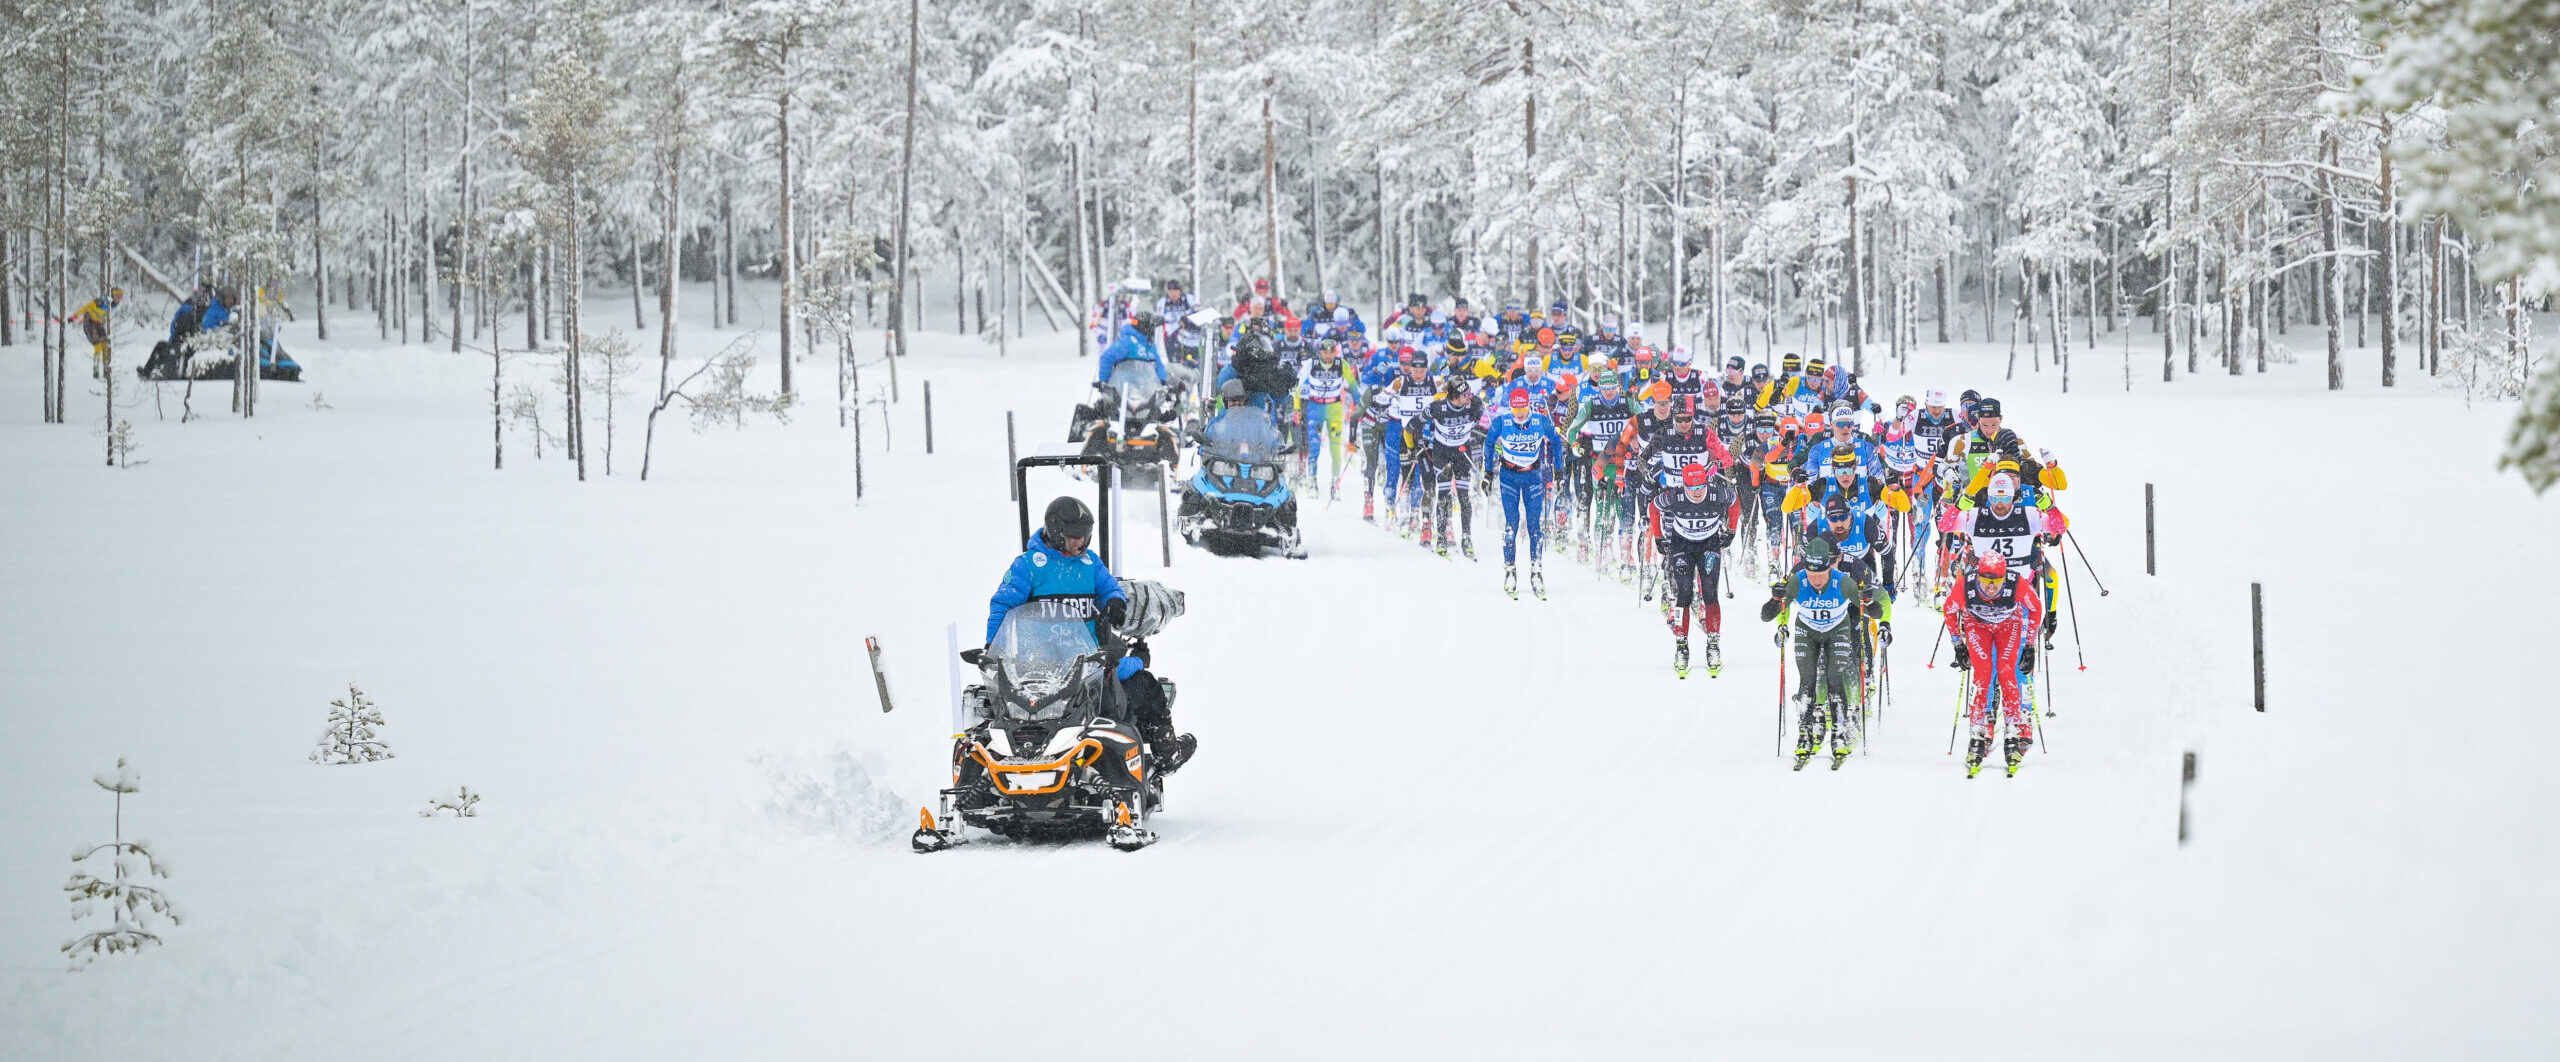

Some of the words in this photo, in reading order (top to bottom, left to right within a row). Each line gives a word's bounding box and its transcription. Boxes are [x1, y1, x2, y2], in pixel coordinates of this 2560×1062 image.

[1407, 386, 1431, 396] IBM
[1415, 397, 1423, 410] 5
[1599, 421, 1624, 434] 100
[1505, 432, 1539, 442] ahlsell
[1509, 441, 1536, 452] 225
[1687, 520, 1707, 529] 10
[1837, 542, 1863, 552] sell
[1991, 538, 2014, 558] 43
[1039, 598, 1058, 618] TV
[1800, 597, 1839, 608] ahlsell
[2001, 622, 2019, 660] Internorm
